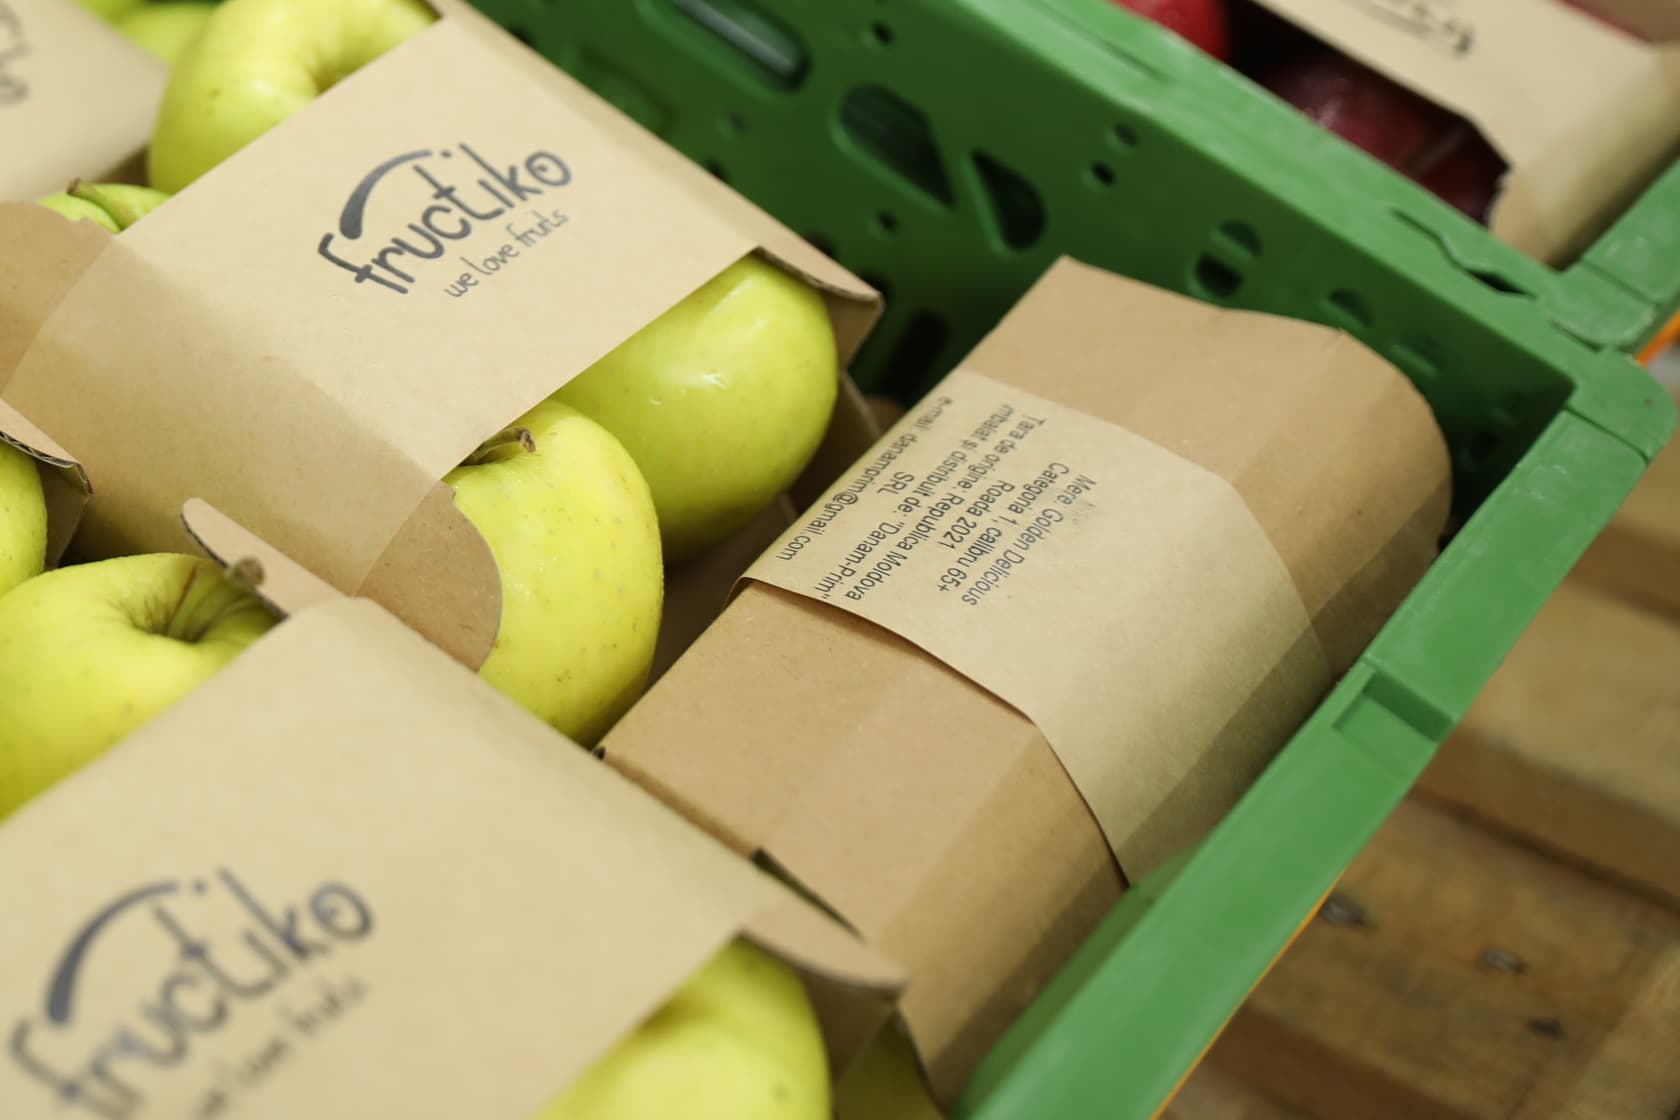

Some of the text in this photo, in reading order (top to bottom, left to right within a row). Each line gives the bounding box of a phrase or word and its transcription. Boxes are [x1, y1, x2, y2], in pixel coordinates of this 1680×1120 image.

[317, 142, 572, 294] fructiko
[444, 209, 570, 298] we love fruits
[993, 439, 1017, 454] de
[877, 471, 916, 495] SRL
[1007, 462, 1070, 514] Categoria
[896, 492, 966, 551] Republica
[937, 479, 1016, 550] Roada 2021
[1011, 507, 1064, 551] Golden
[957, 527, 1003, 567] calibru
[844, 550, 908, 601] Moldova
[937, 567, 968, 592] 65+
[961, 549, 1026, 606] Delicious
